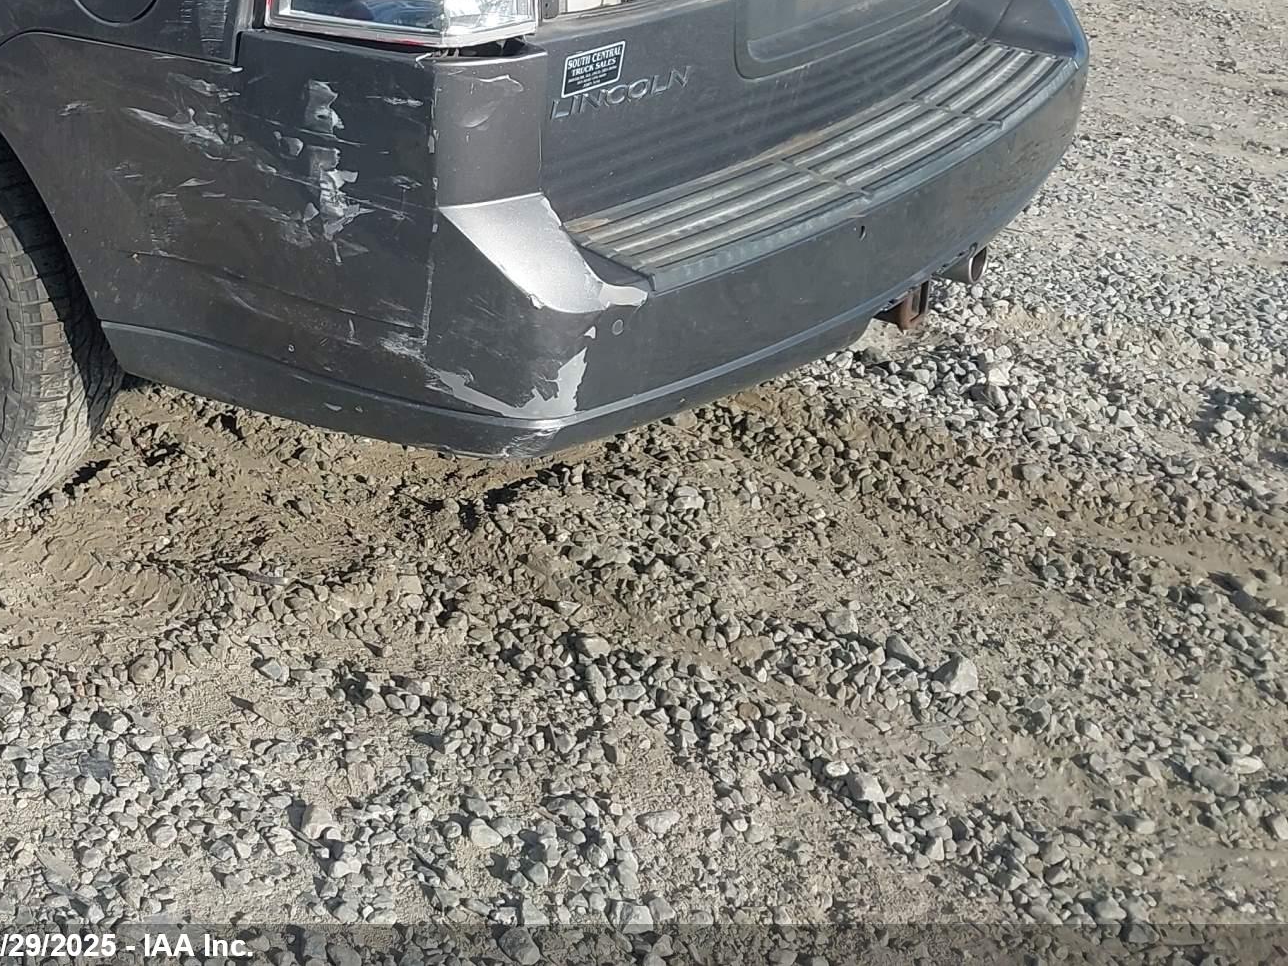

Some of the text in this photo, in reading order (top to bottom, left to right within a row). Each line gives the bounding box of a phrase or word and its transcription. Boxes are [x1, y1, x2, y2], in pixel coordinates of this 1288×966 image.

[568, 46, 621, 70] SOUTH CENTRAL
[571, 63, 595, 77] TRUCK
[595, 57, 617, 70] SALES
[551, 67, 691, 119] LINCOLN
